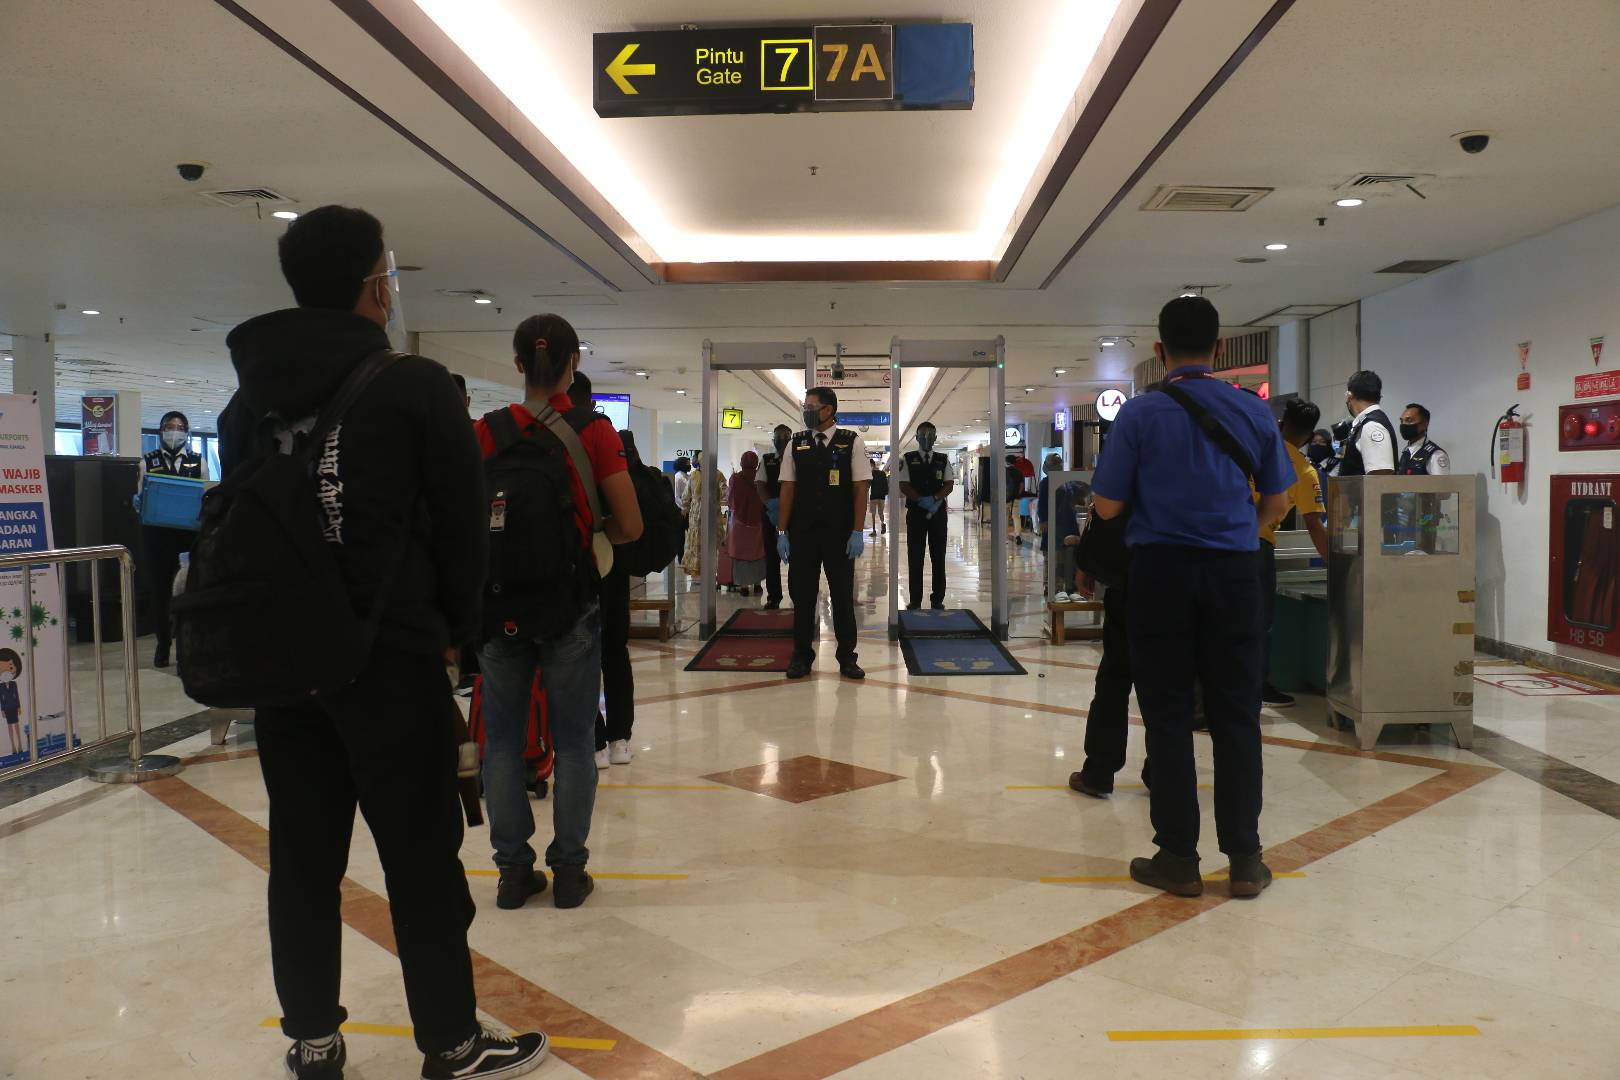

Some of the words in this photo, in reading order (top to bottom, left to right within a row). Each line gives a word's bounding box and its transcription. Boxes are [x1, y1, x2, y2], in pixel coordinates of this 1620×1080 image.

[696, 48, 744, 65] Pintu
[822, 43, 886, 82] 7A
[775, 47, 799, 82] 7
[696, 68, 742, 85] Gate
[728, 413, 737, 424] 7
[676, 449, 696, 457] GAT
[3, 468, 41, 480] WAJIB
[1571, 481, 1613, 496] HYDRANT
[0, 538, 33, 549] ARAN
